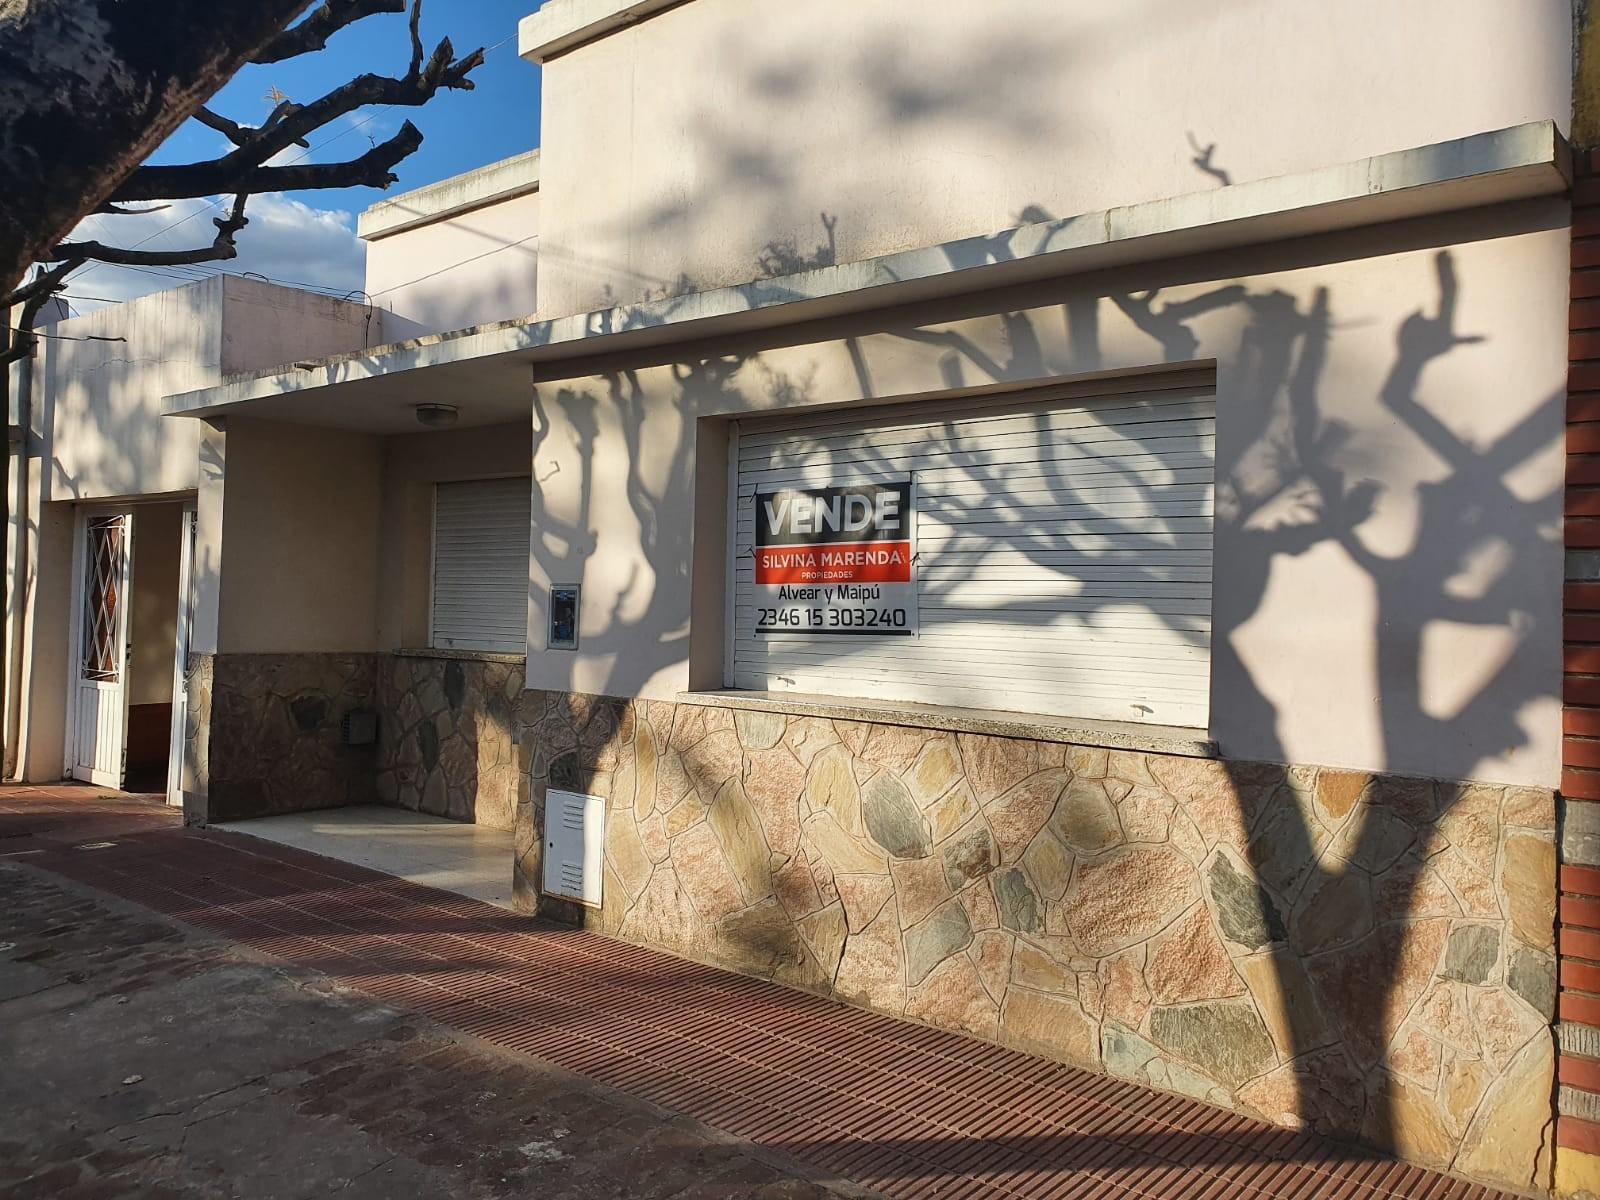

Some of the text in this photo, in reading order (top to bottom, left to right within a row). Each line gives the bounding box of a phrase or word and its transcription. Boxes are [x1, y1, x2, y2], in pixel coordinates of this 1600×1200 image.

[764, 491, 901, 536] VENDE
[762, 550, 902, 568] SILVINA MARENDA
[801, 570, 853, 580] PROPIEDADES
[778, 583, 880, 604] Alvear y Maipú
[757, 608, 906, 627] 2346 15 303240
